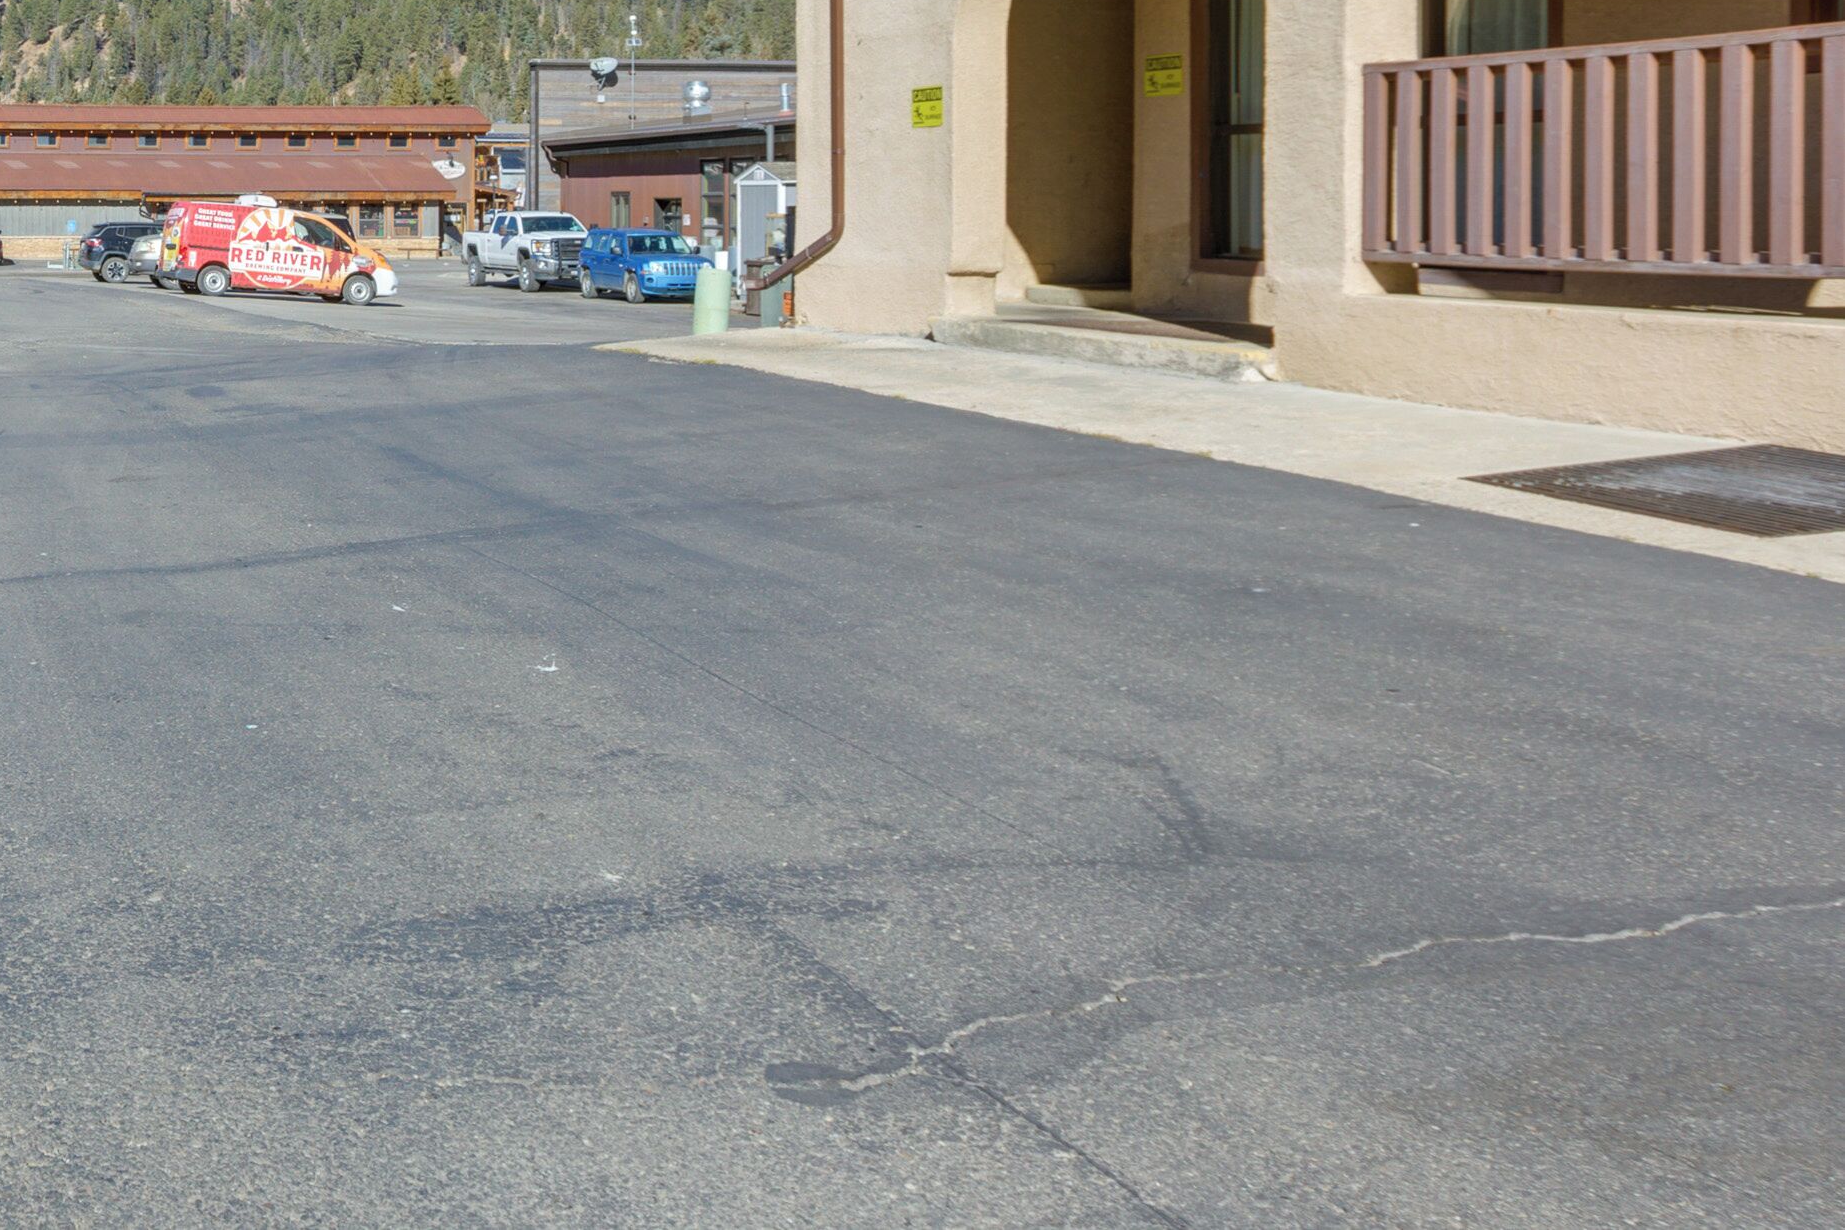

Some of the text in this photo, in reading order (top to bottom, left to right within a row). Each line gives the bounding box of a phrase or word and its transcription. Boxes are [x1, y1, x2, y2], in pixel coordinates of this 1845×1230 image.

[1147, 57, 1181, 70] CAUTION
[913, 88, 942, 101] CAUTION
[195, 213, 214, 221] GREAT
[231, 247, 322, 271] RED RIVER
[245, 263, 306, 274] BREWING COMPANY
